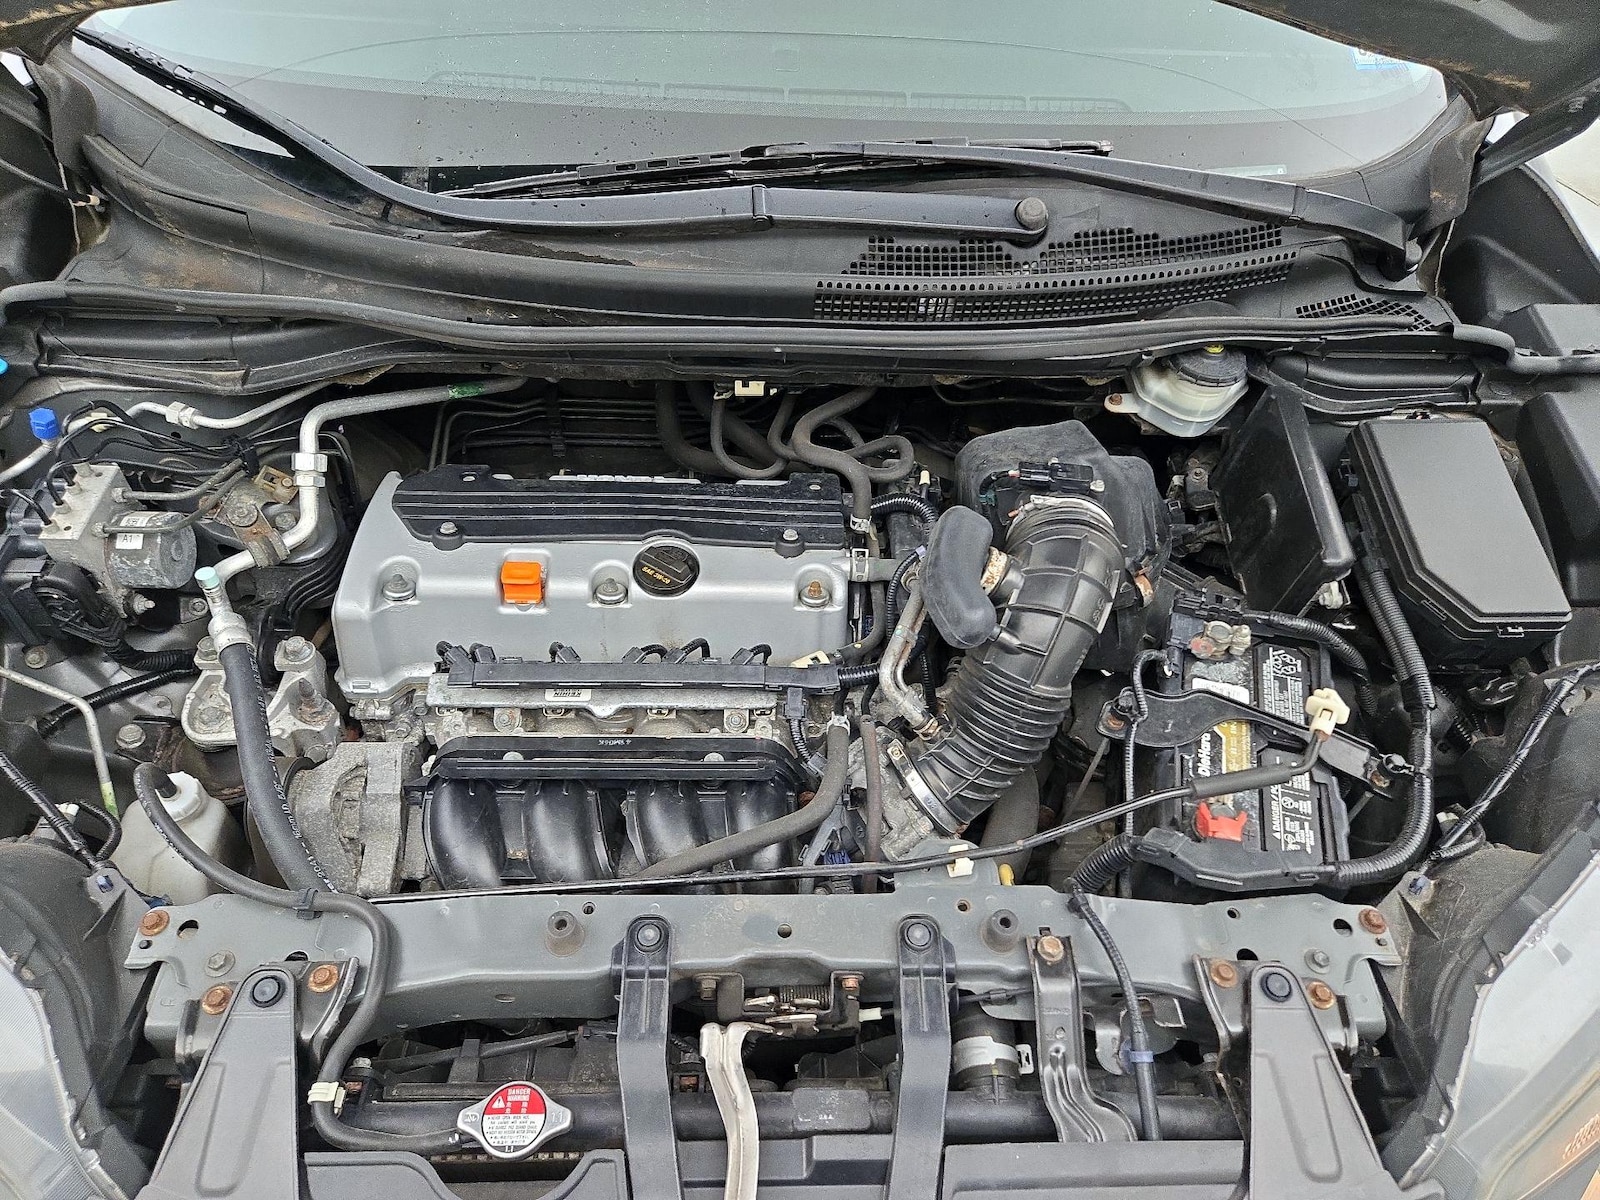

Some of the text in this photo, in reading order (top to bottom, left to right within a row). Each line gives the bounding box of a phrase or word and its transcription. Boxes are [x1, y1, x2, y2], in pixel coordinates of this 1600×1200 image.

[641, 566, 655, 576] SAE
[1271, 801, 1281, 831] DANGER
[508, 1088, 531, 1096] DANGER
